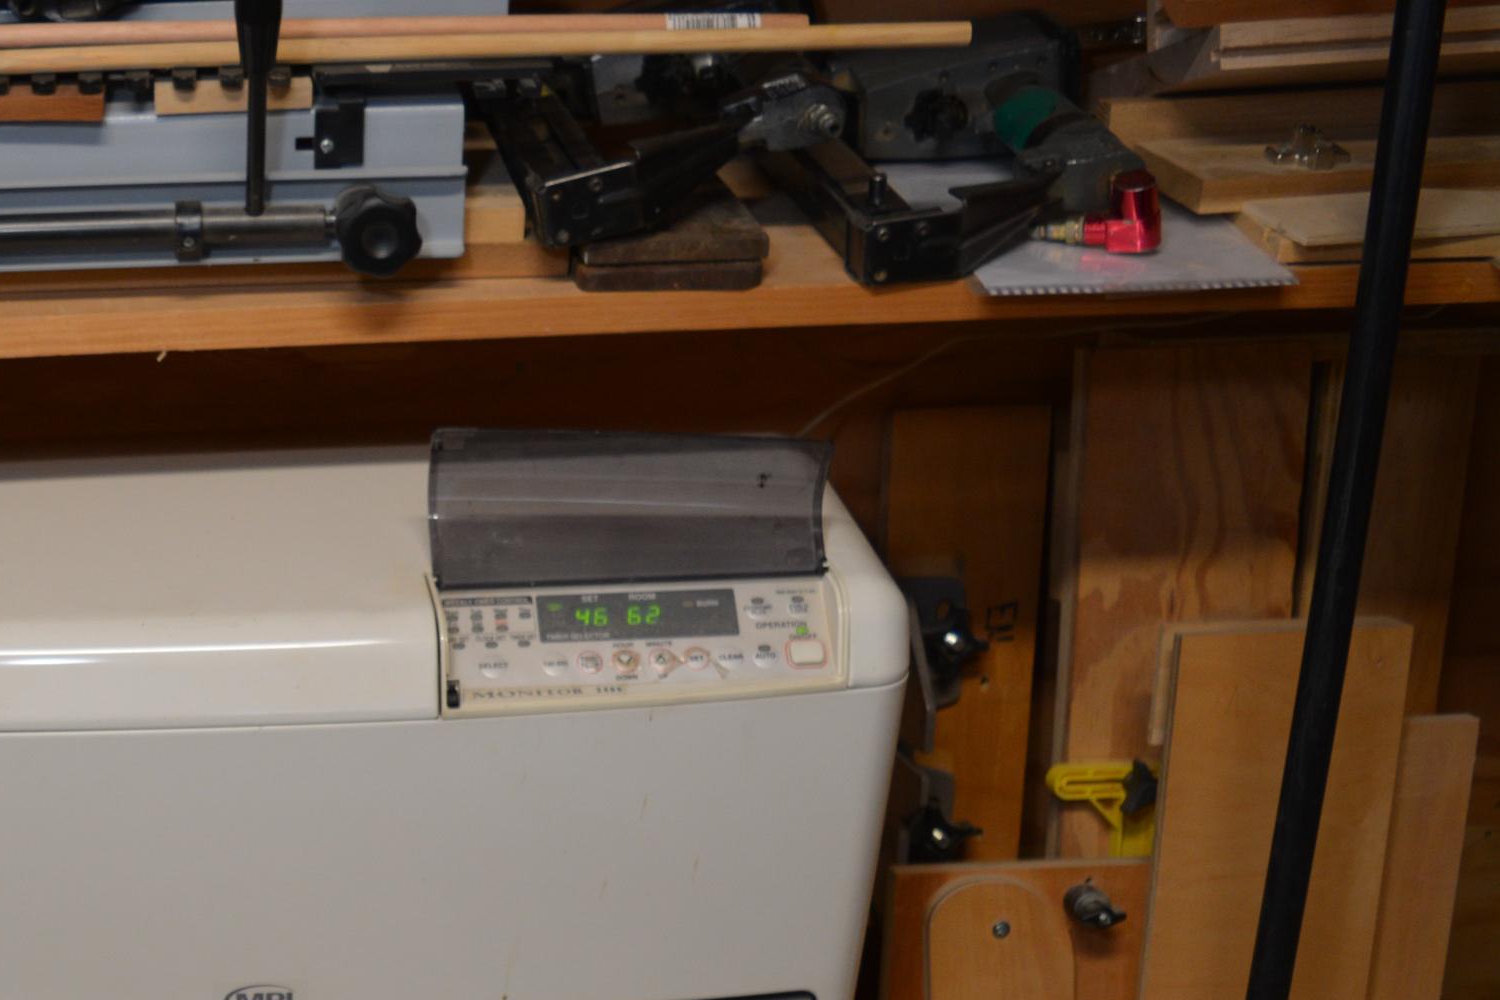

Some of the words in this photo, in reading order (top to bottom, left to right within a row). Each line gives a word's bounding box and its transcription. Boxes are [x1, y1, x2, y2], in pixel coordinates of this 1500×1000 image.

[627, 592, 657, 601] ROOM
[575, 607, 608, 626] 46
[627, 604, 661, 625] 62
